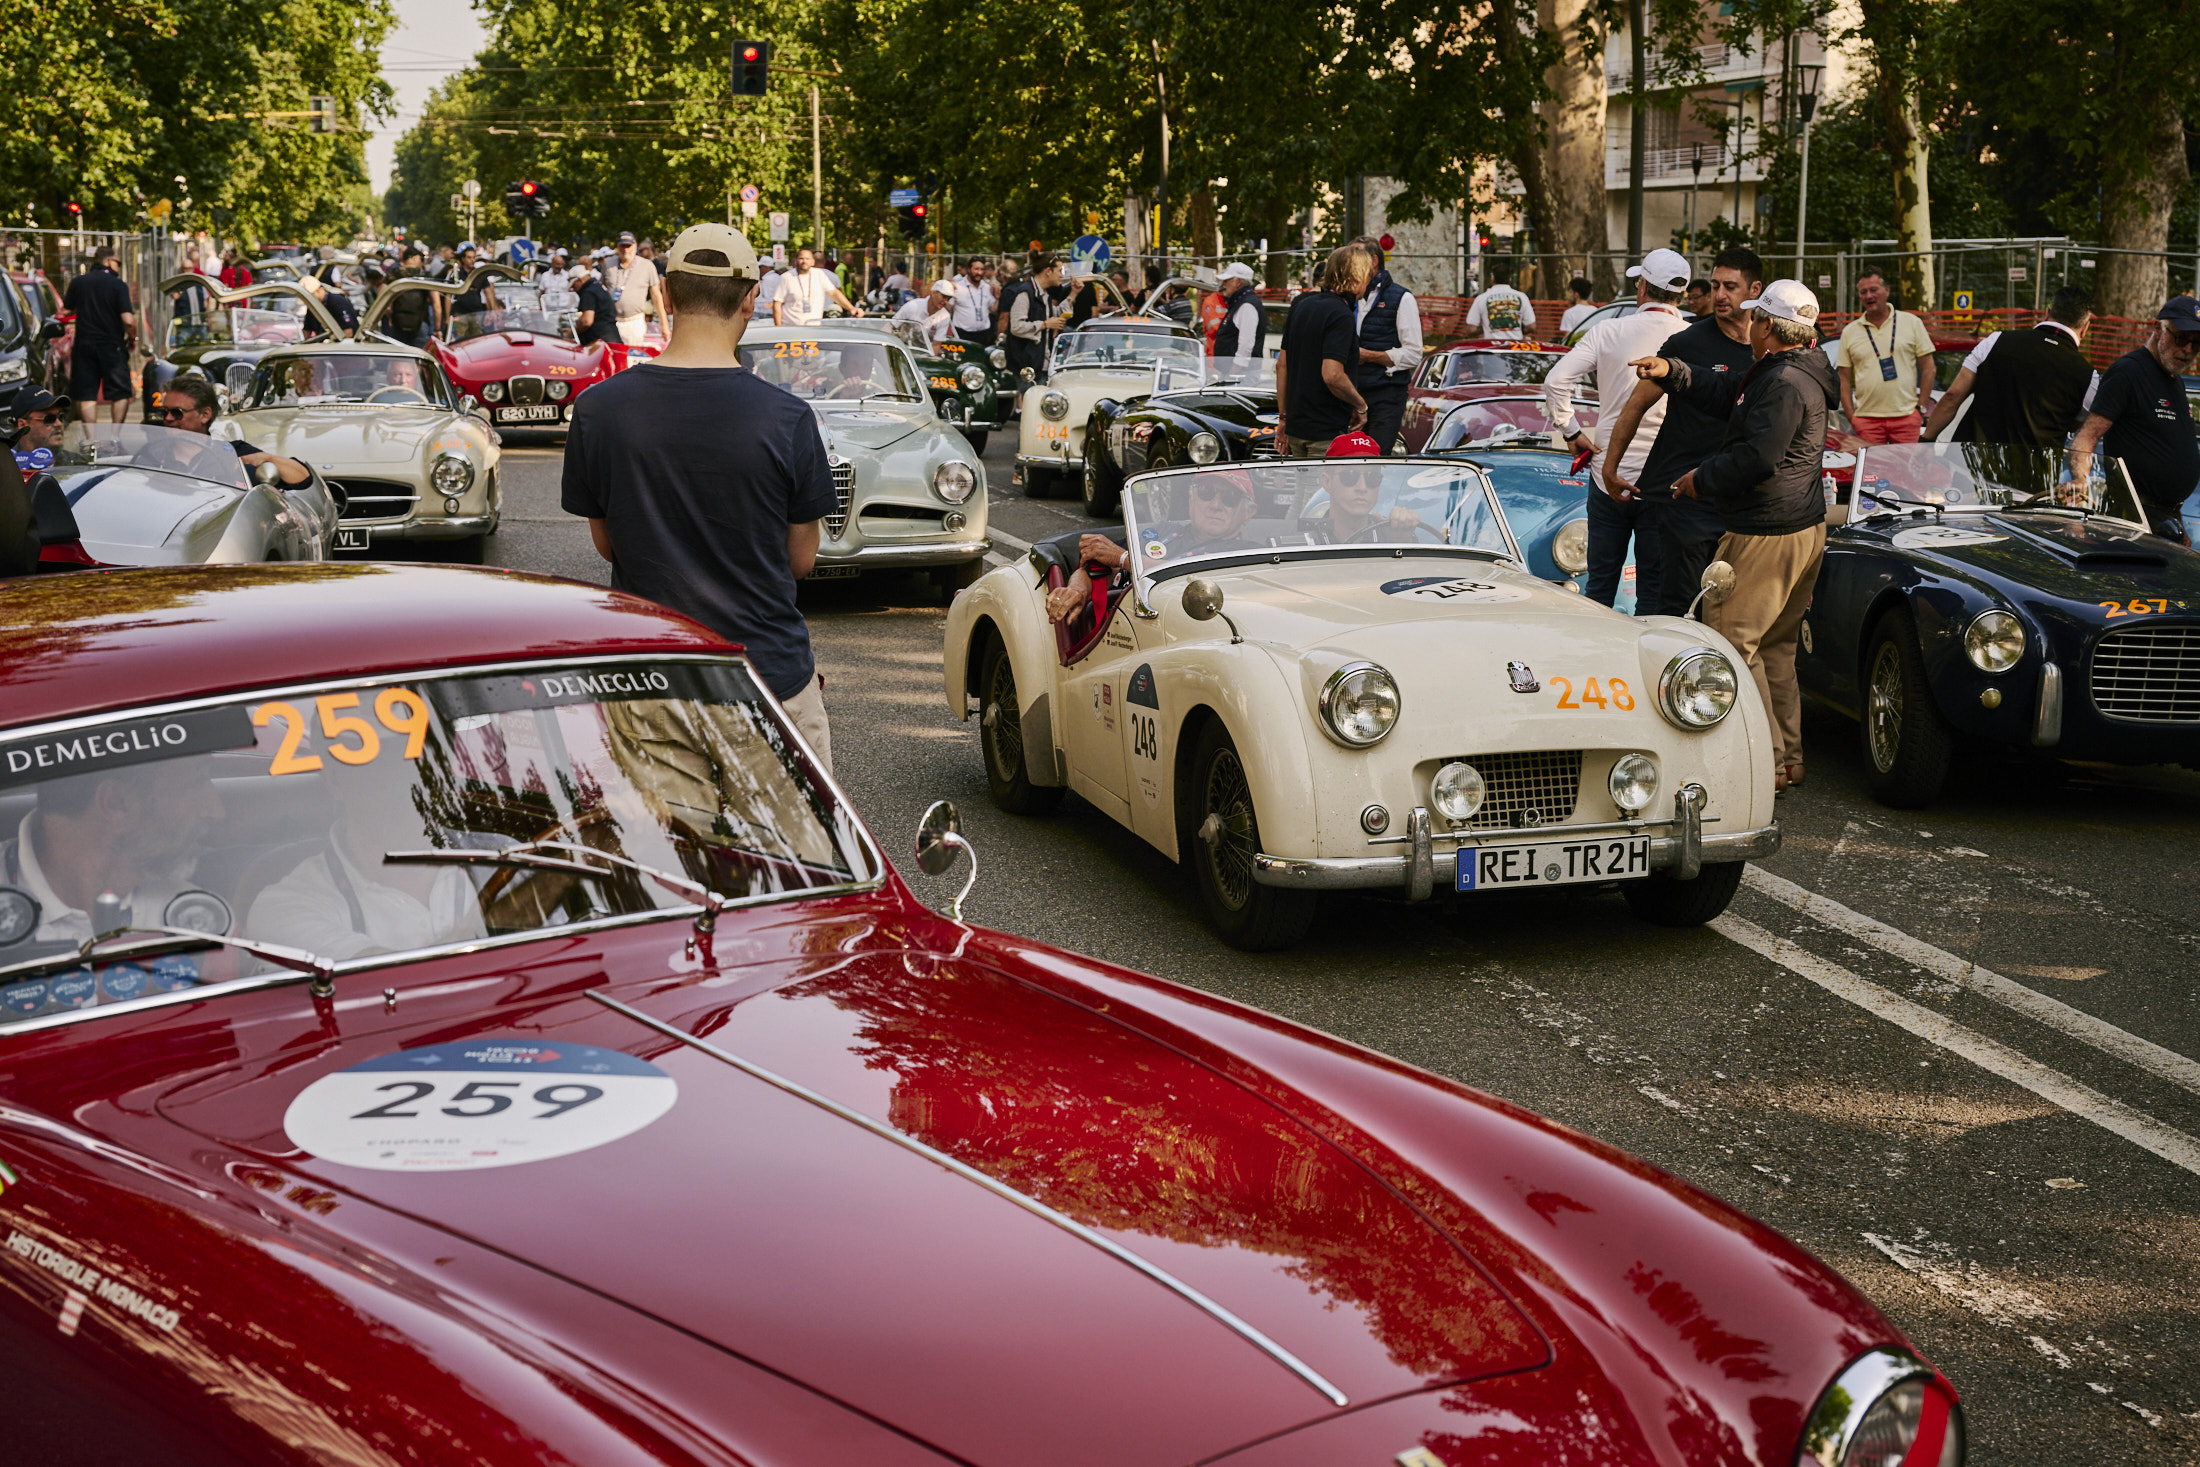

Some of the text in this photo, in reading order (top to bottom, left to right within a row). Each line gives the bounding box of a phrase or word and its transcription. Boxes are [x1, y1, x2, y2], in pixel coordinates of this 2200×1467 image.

[774, 341, 820, 358] 253
[1509, 342, 1541, 351] 255
[549, 365, 577, 375] 290
[930, 376, 958, 389] 285
[501, 406, 553, 420] 620 UYH
[1036, 423, 1068, 439] 284
[1248, 426, 1278, 438] 26
[1351, 438, 1371, 447] TR2
[335, 531, 360, 546] VL
[1414, 582, 1496, 599] 248
[2099, 599, 2168, 619] 267
[1548, 676, 1635, 712] 248
[252, 687, 429, 776] 259
[1131, 712, 1157, 761] 248
[1480, 849, 1538, 884] REI
[1462, 873, 1470, 884] D
[350, 1082, 604, 1120] 259
[5, 1230, 180, 1332] HISTORIQUE MONACO
